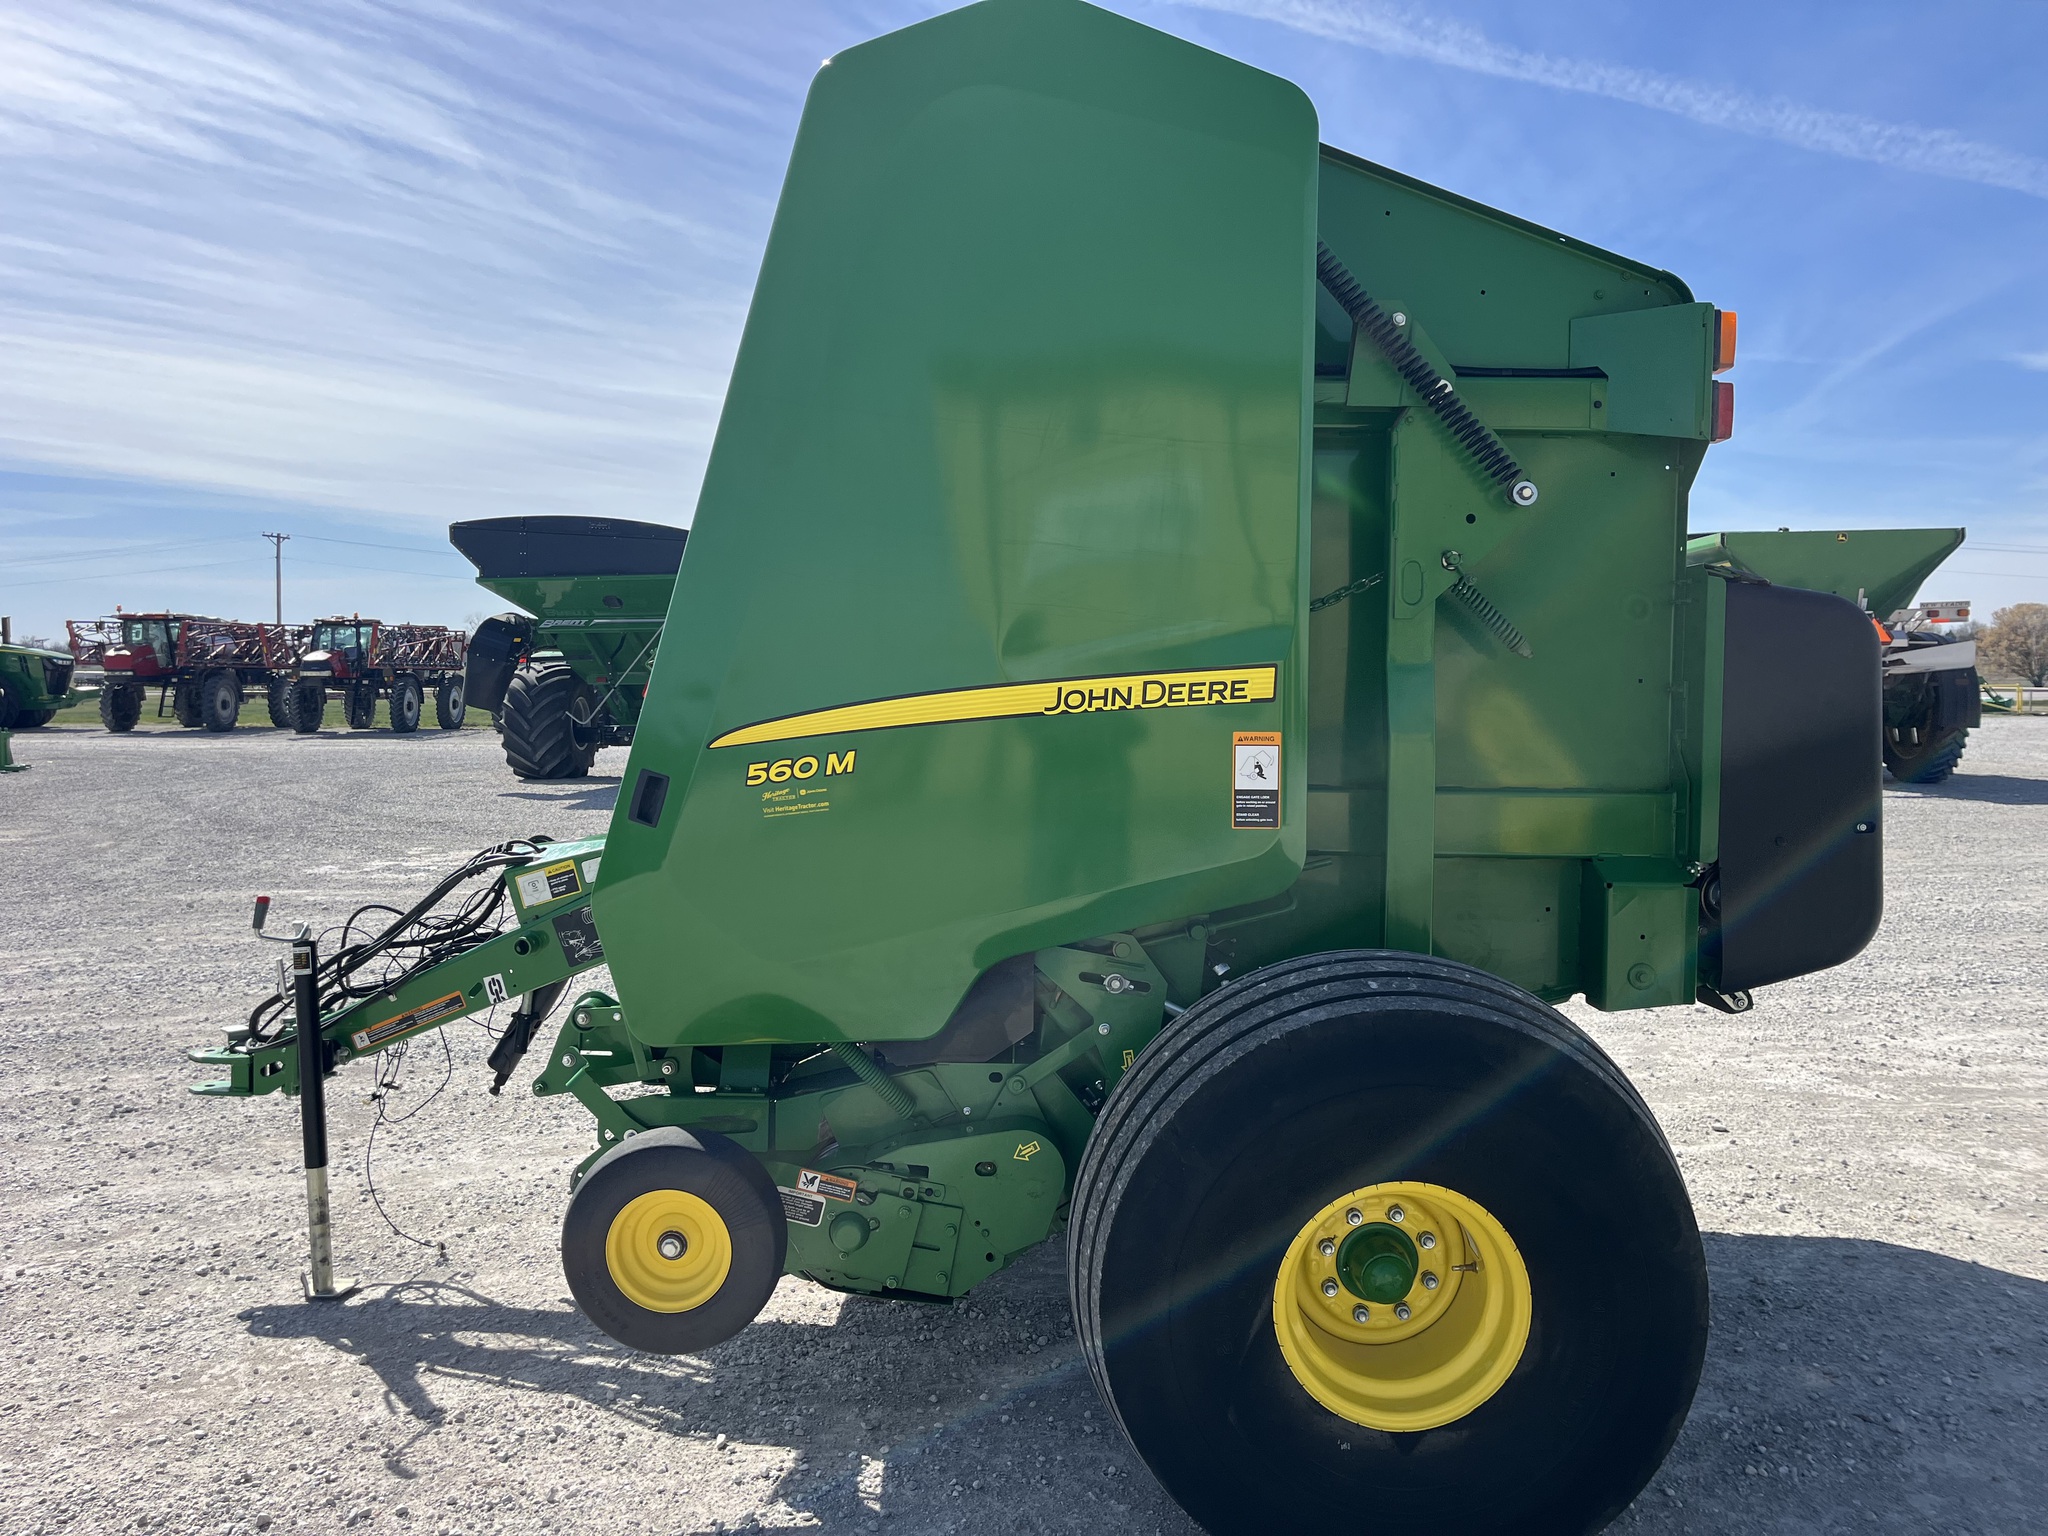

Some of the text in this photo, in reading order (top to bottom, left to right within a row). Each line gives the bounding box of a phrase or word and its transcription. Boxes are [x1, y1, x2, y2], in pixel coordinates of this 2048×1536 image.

[539, 619, 589, 628] BRENT
[1043, 679, 1250, 713] JOHN DEERE
[745, 749, 857, 787] 560 M
[761, 787, 791, 801] Heritage
[775, 801, 830, 813] HeritageTractor.com
